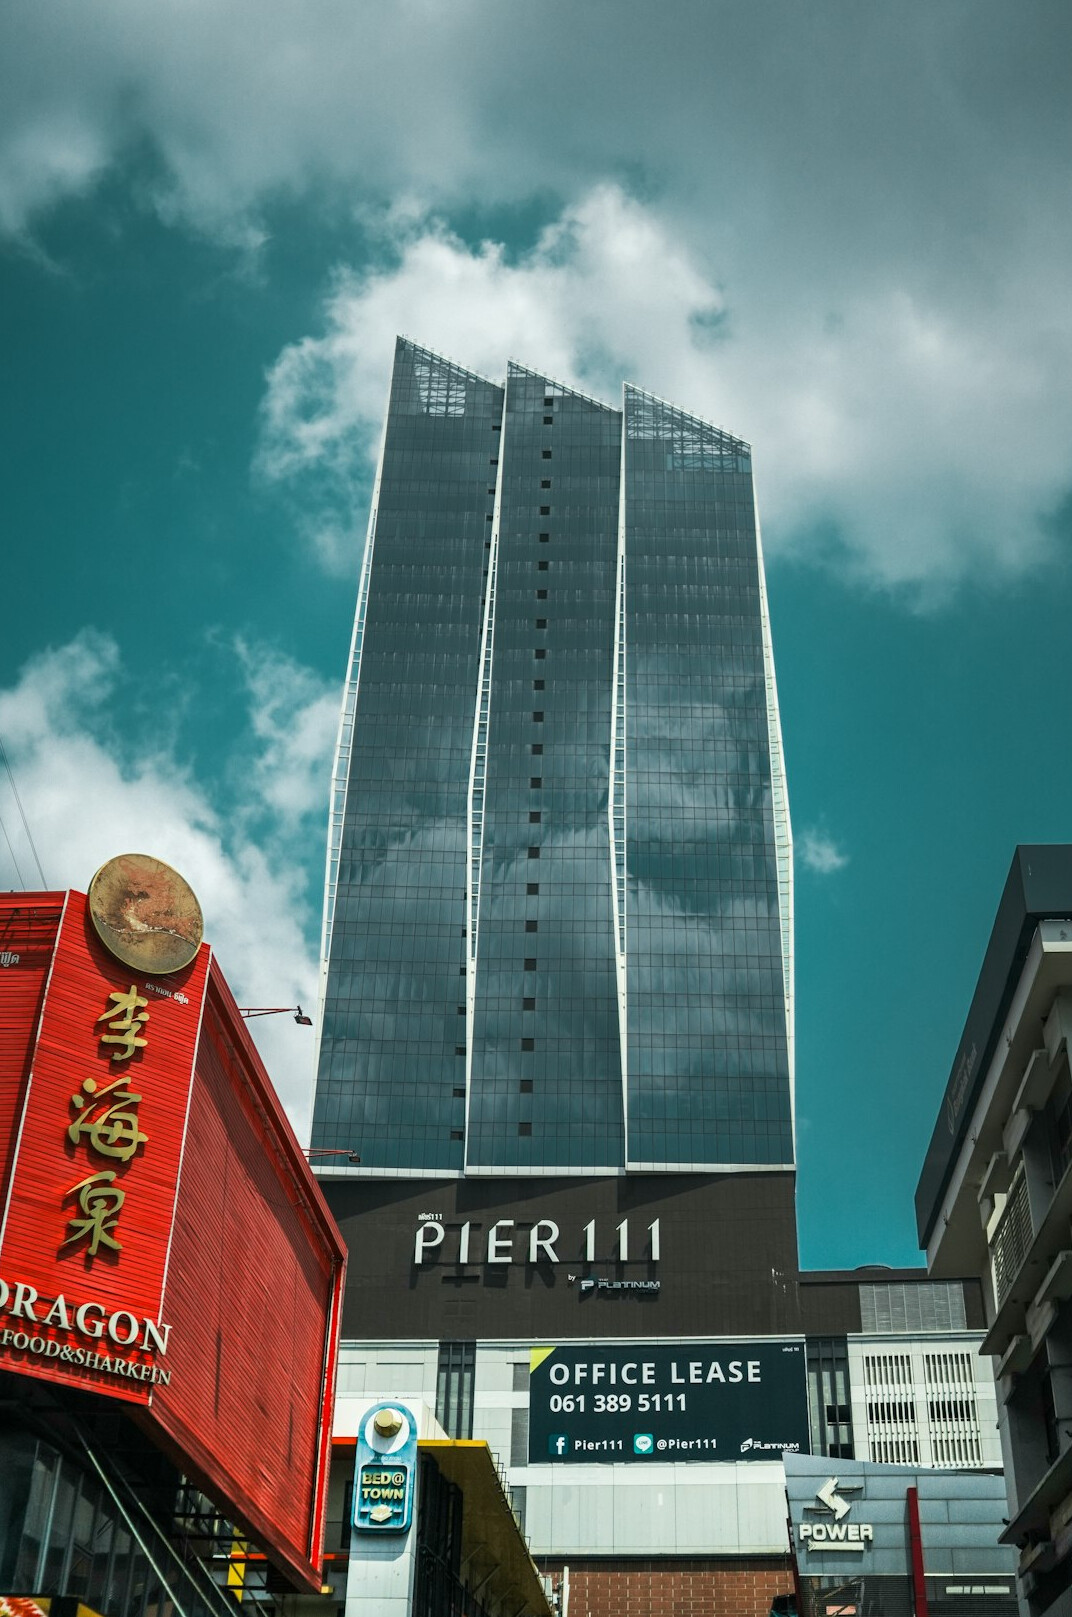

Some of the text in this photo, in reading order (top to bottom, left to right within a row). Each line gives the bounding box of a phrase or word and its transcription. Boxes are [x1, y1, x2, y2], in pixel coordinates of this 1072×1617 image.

[414, 1218, 660, 1264] PIER 111
[567, 1273, 577, 1282] by
[549, 1360, 762, 1385] OFFICE LEASE
[549, 1393, 686, 1413] 061 389 5111
[574, 1439, 623, 1451] Pier111
[656, 1438, 717, 1451] @Pier111
[362, 1487, 404, 1500] TOWN
[799, 1523, 873, 1541] POWER
